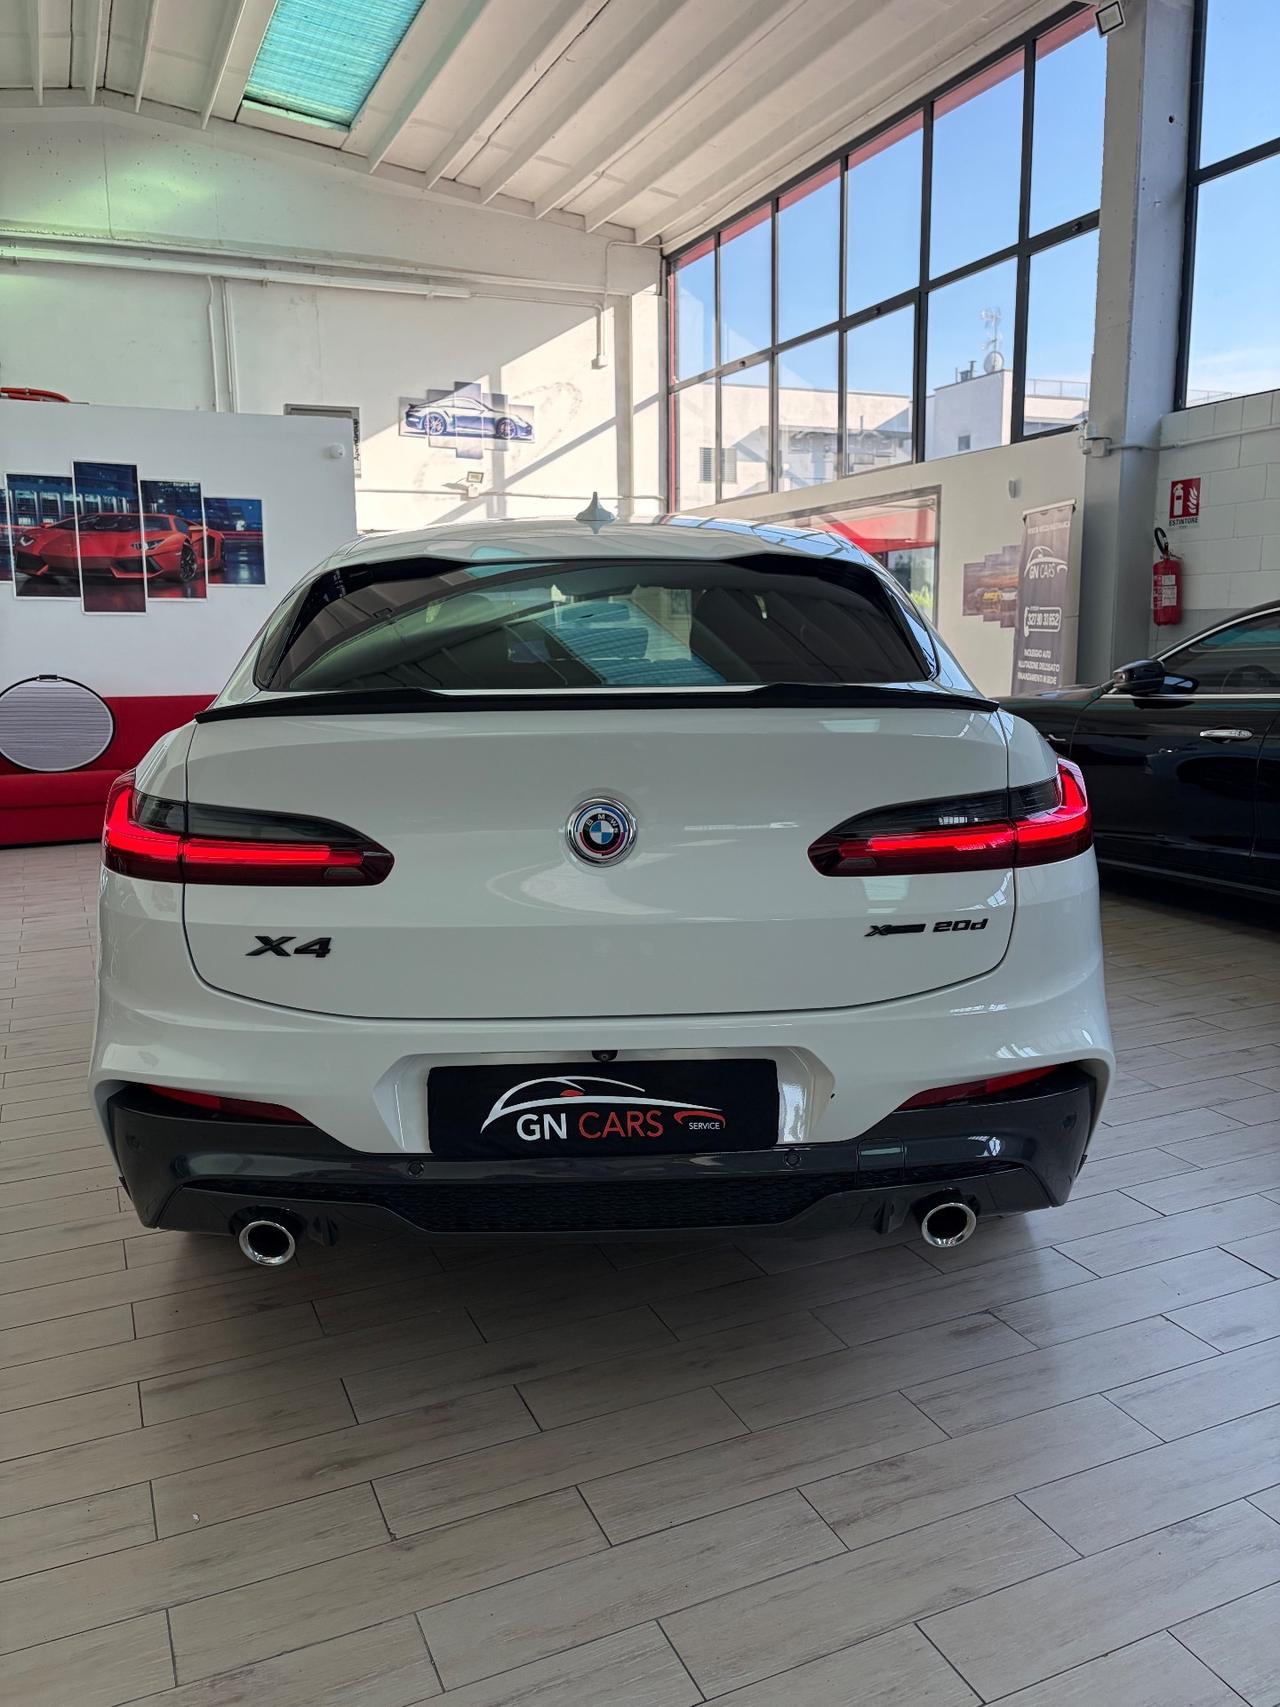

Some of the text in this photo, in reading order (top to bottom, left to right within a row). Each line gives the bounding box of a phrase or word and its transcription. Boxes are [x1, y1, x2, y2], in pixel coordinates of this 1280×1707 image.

[1169, 517, 1198, 526] ESTINTORE
[1029, 565, 1039, 579] GN
[586, 814, 618, 827] BMW
[932, 918, 988, 933] 20d
[245, 936, 332, 958] X4
[516, 1110, 721, 1141] GN CARS SERVICE
